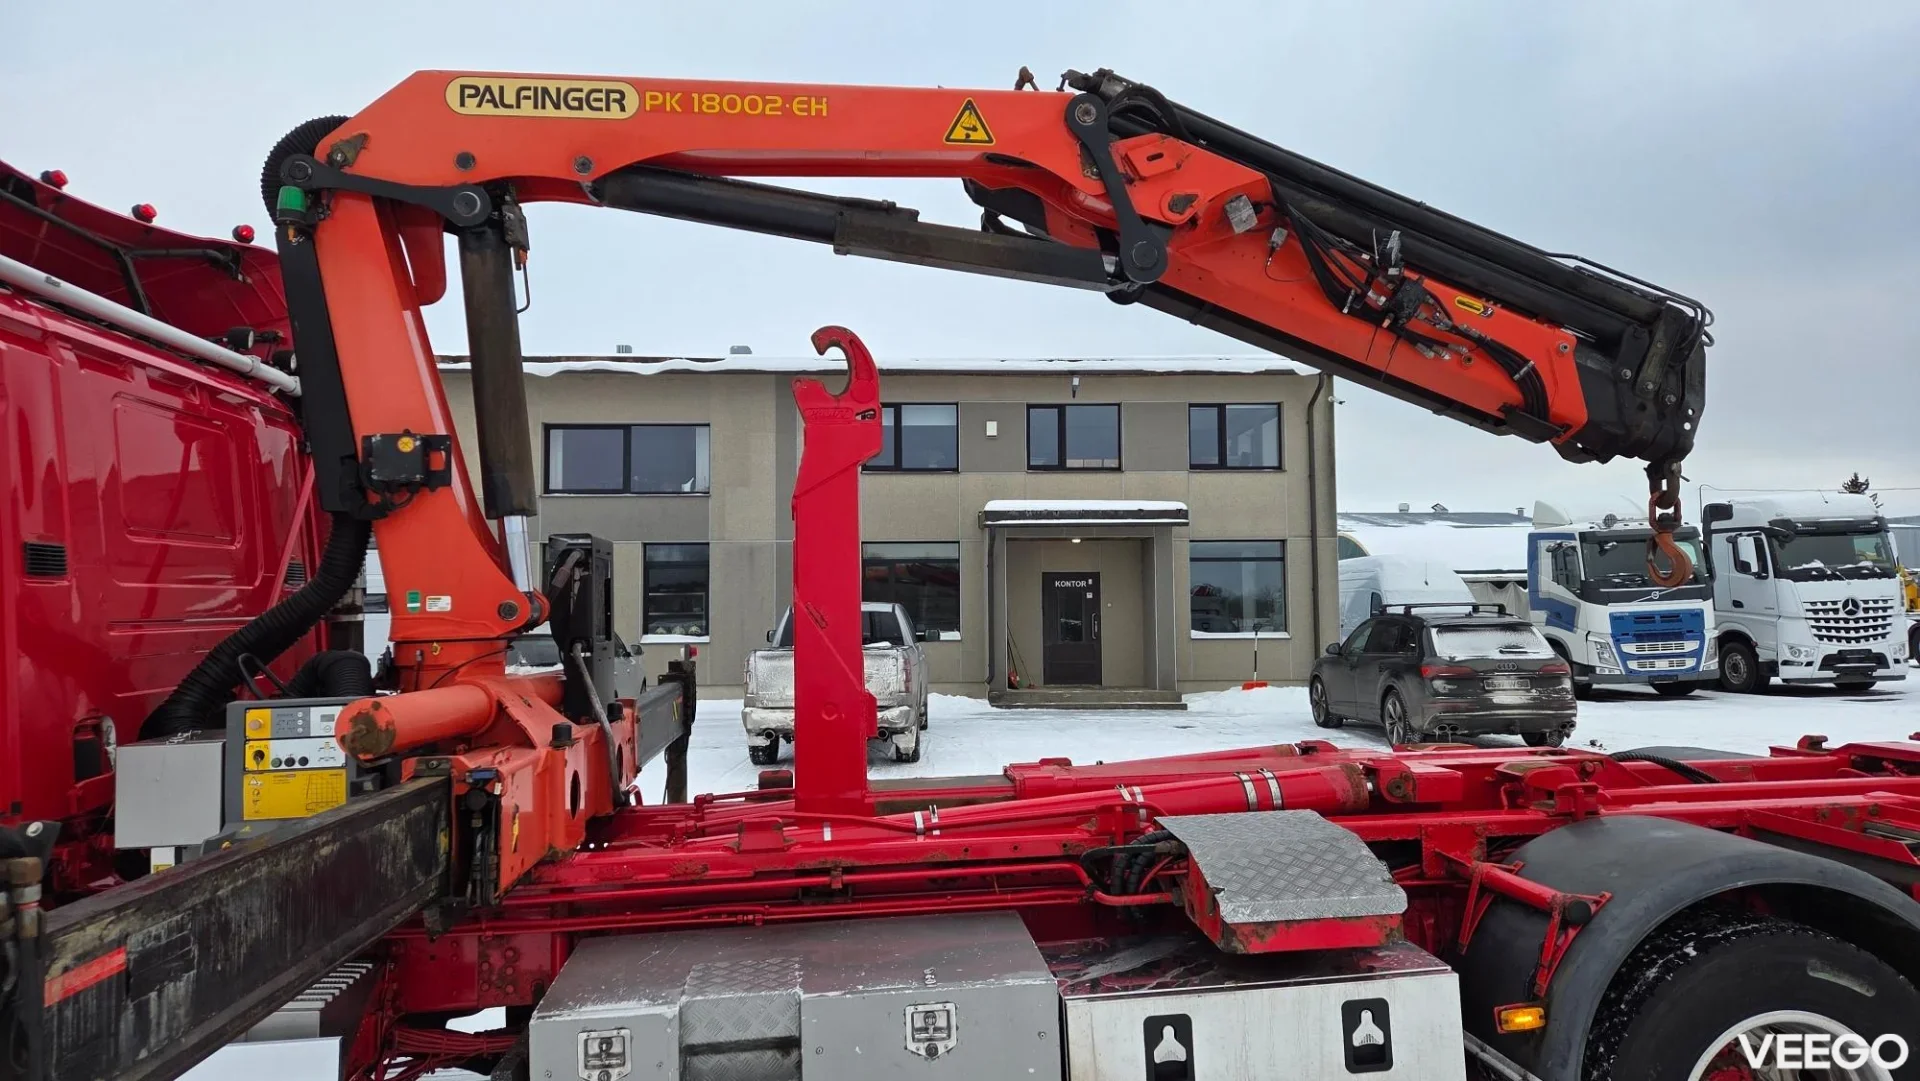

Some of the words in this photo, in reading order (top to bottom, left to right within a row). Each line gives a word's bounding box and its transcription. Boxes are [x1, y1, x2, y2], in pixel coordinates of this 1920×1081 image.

[459, 83, 626, 113] PALFINGER
[645, 91, 682, 112] PK
[1055, 580, 1087, 588] KONTOR
